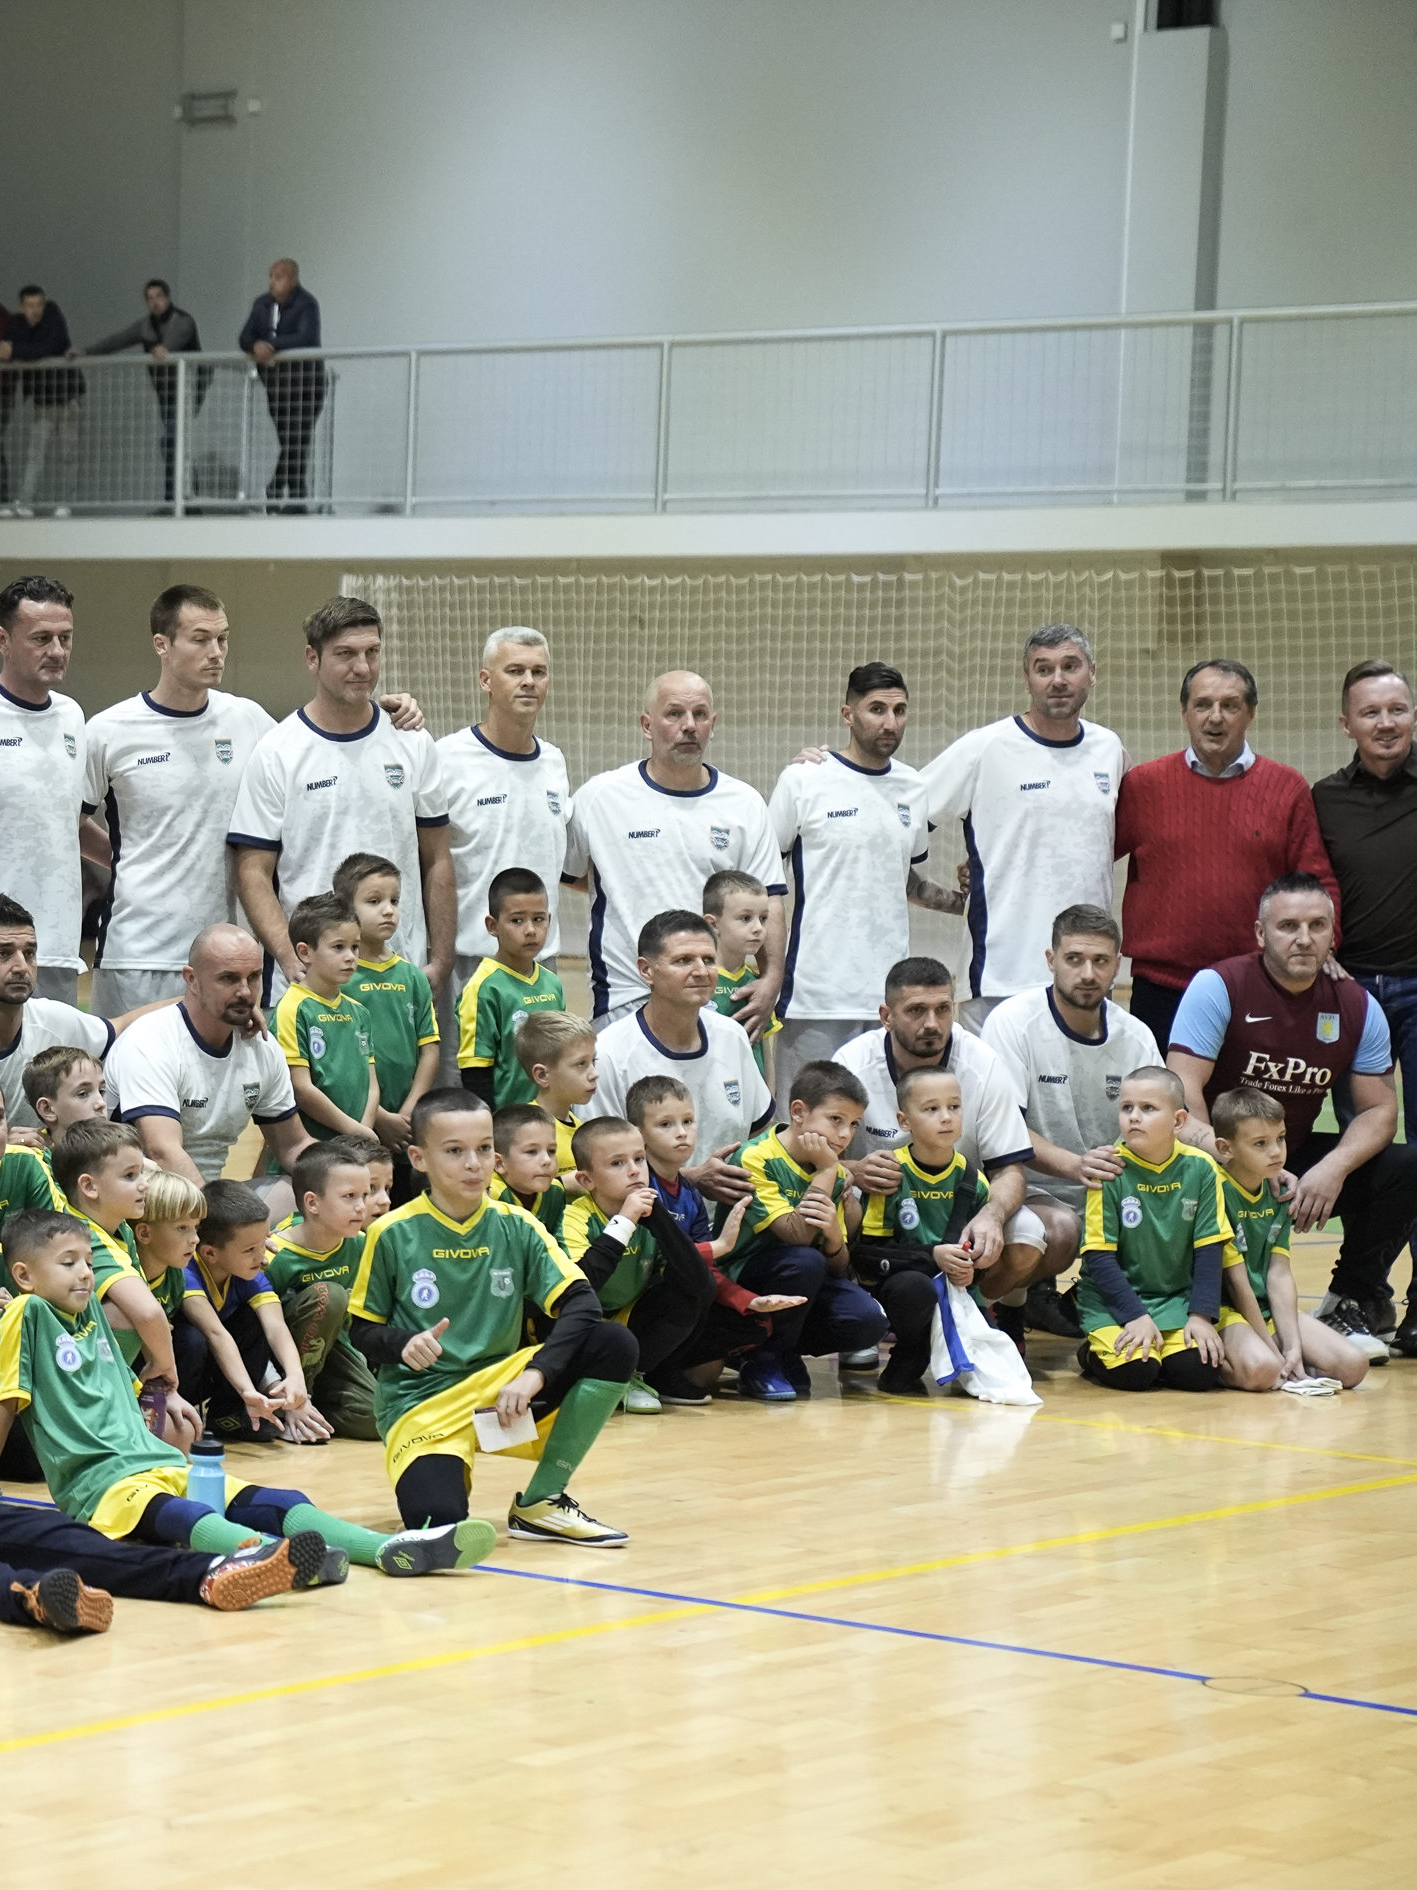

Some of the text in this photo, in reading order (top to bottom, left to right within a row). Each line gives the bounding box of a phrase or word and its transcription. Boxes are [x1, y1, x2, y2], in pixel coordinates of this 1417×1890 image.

[360, 983, 406, 992] GIVOVA
[523, 994, 556, 1004] GIVOVA
[318, 1014, 353, 1022] GIVOVA
[1242, 1051, 1331, 1086] FxPro
[1240, 1077, 1262, 1088] Trade
[1264, 1081, 1286, 1093] Forex
[1289, 1086, 1306, 1094] Like
[432, 1246, 490, 1259] GIVOVA
[302, 1266, 349, 1282] GIVOVA
